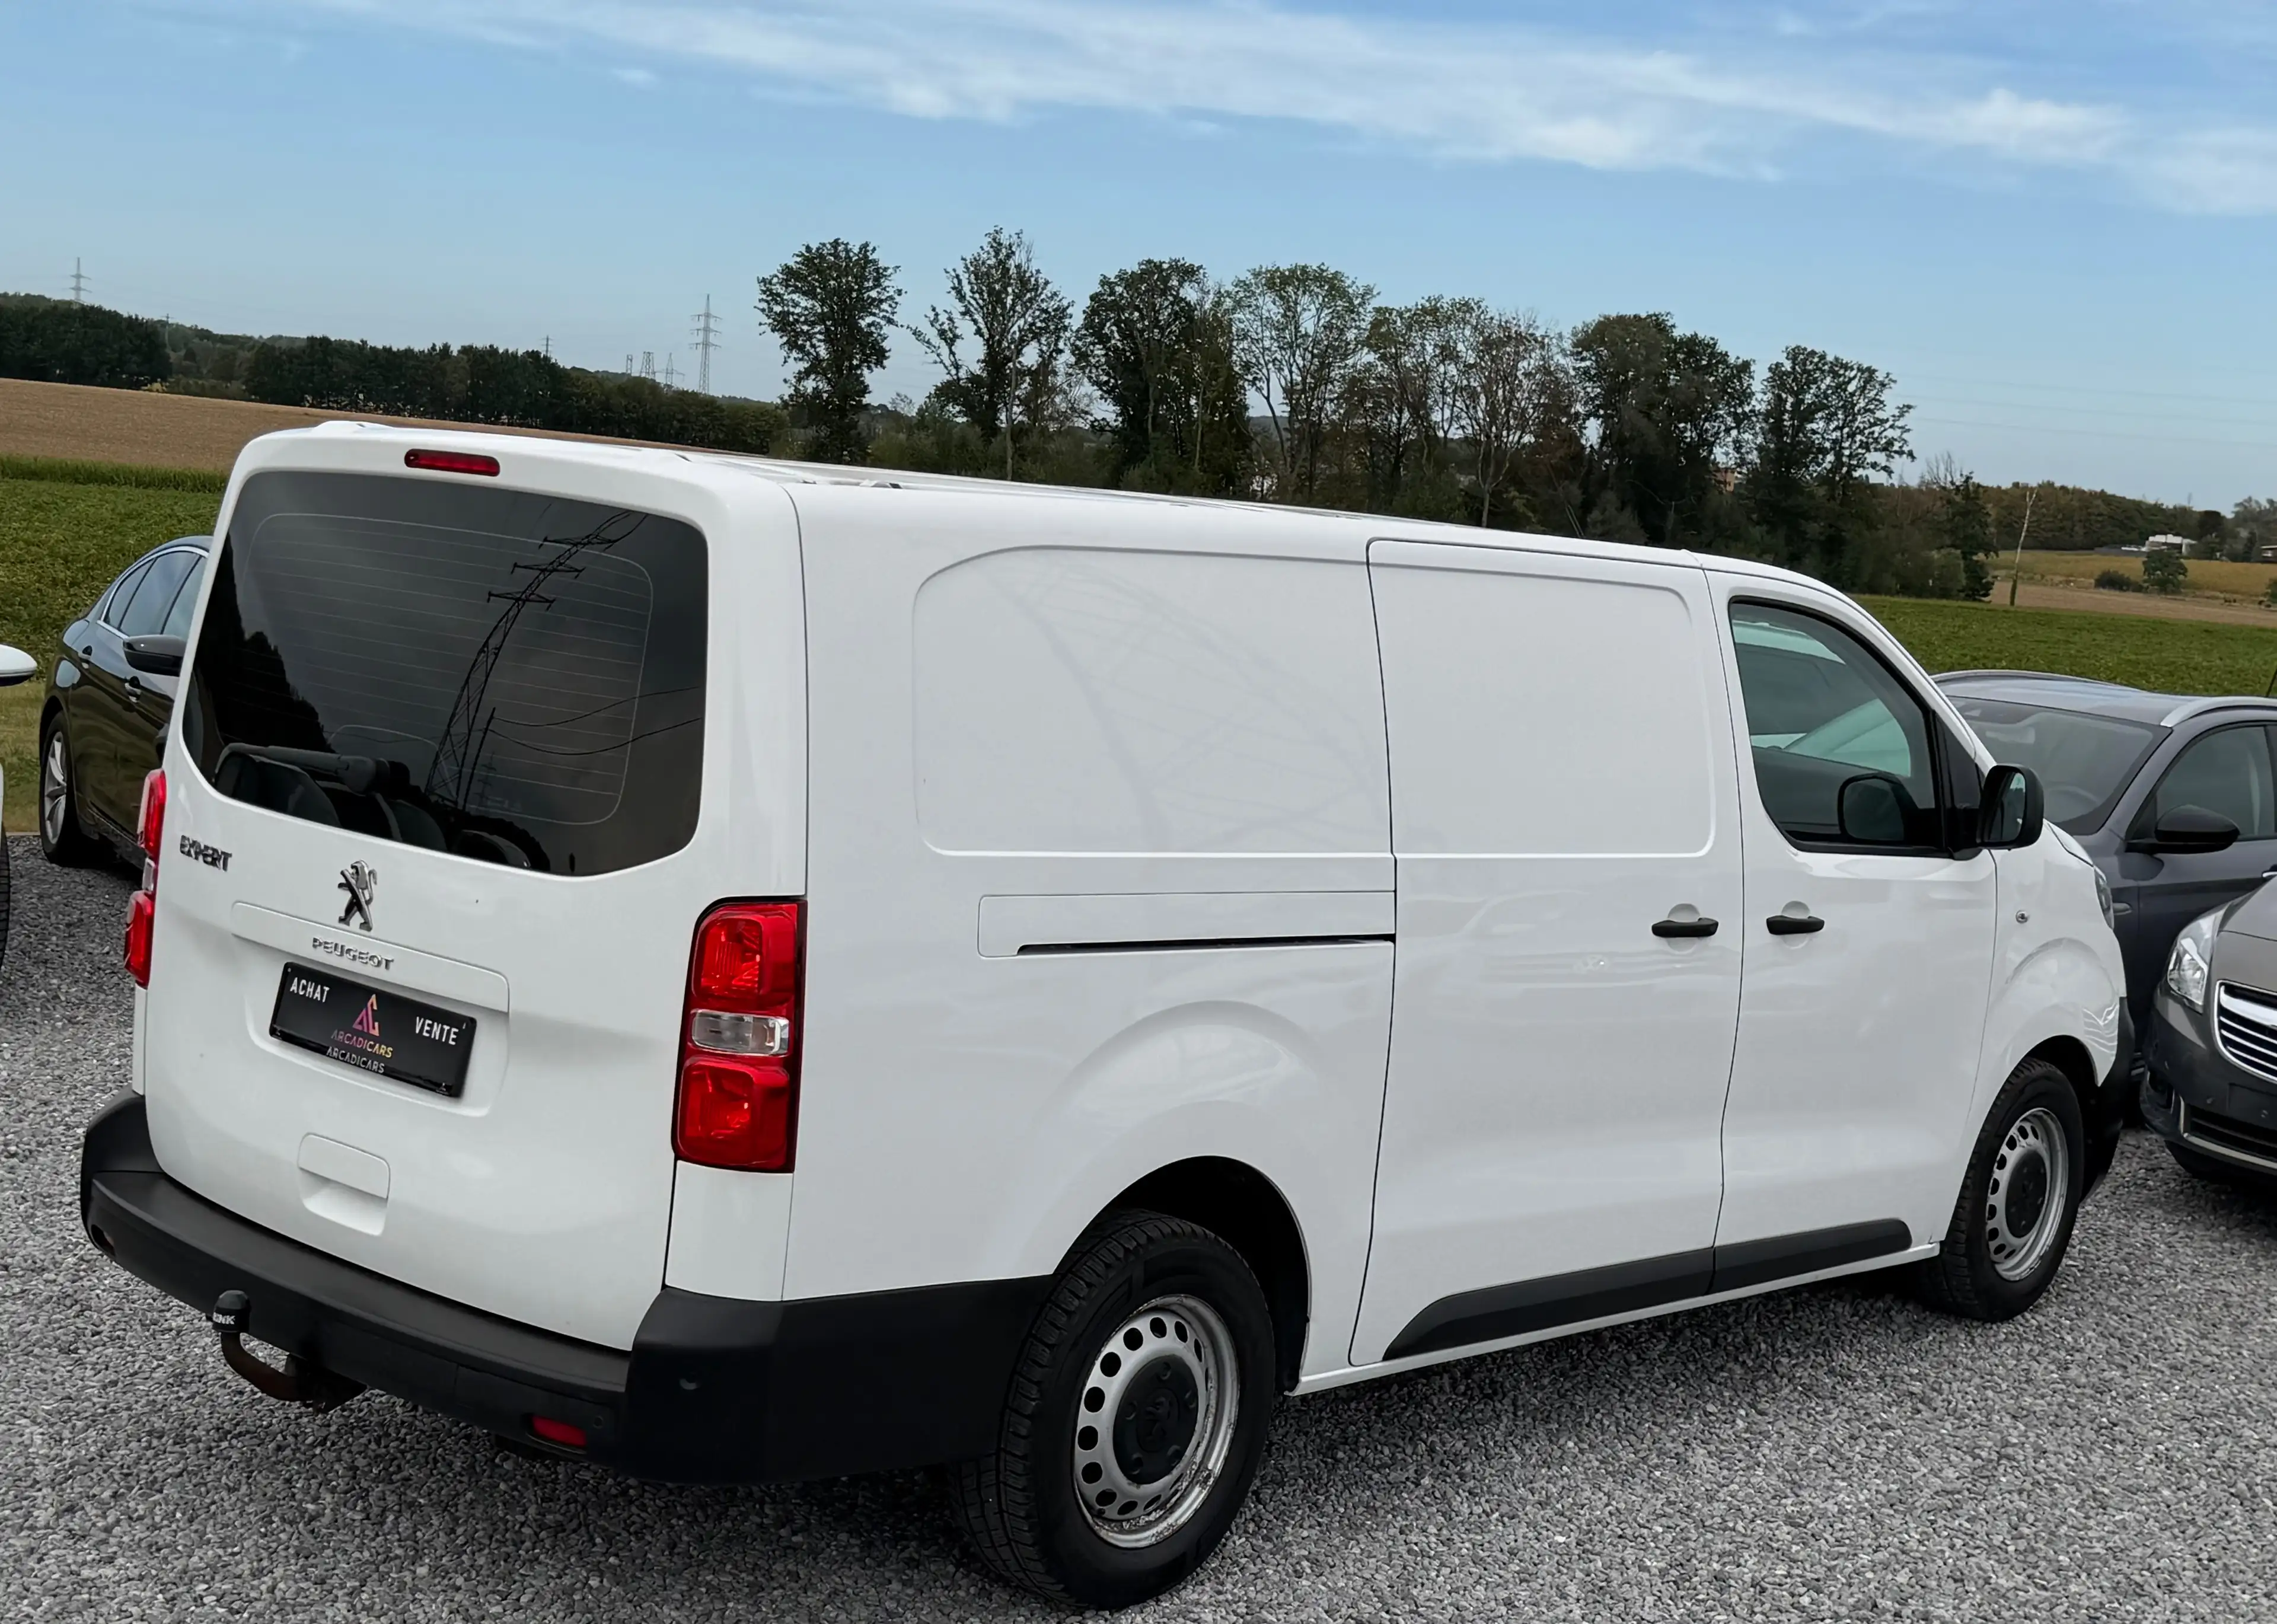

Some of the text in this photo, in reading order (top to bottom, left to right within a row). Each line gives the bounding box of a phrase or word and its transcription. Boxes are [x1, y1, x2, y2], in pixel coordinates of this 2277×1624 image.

[180, 835, 232, 872] EXPERT
[312, 937, 394, 969] PEUGEOT
[290, 977, 329, 1003] ACHAT
[331, 1029, 393, 1058] ARCADICARS
[416, 1017, 459, 1045] VENTE
[326, 1046, 385, 1074] ARCADICARS
